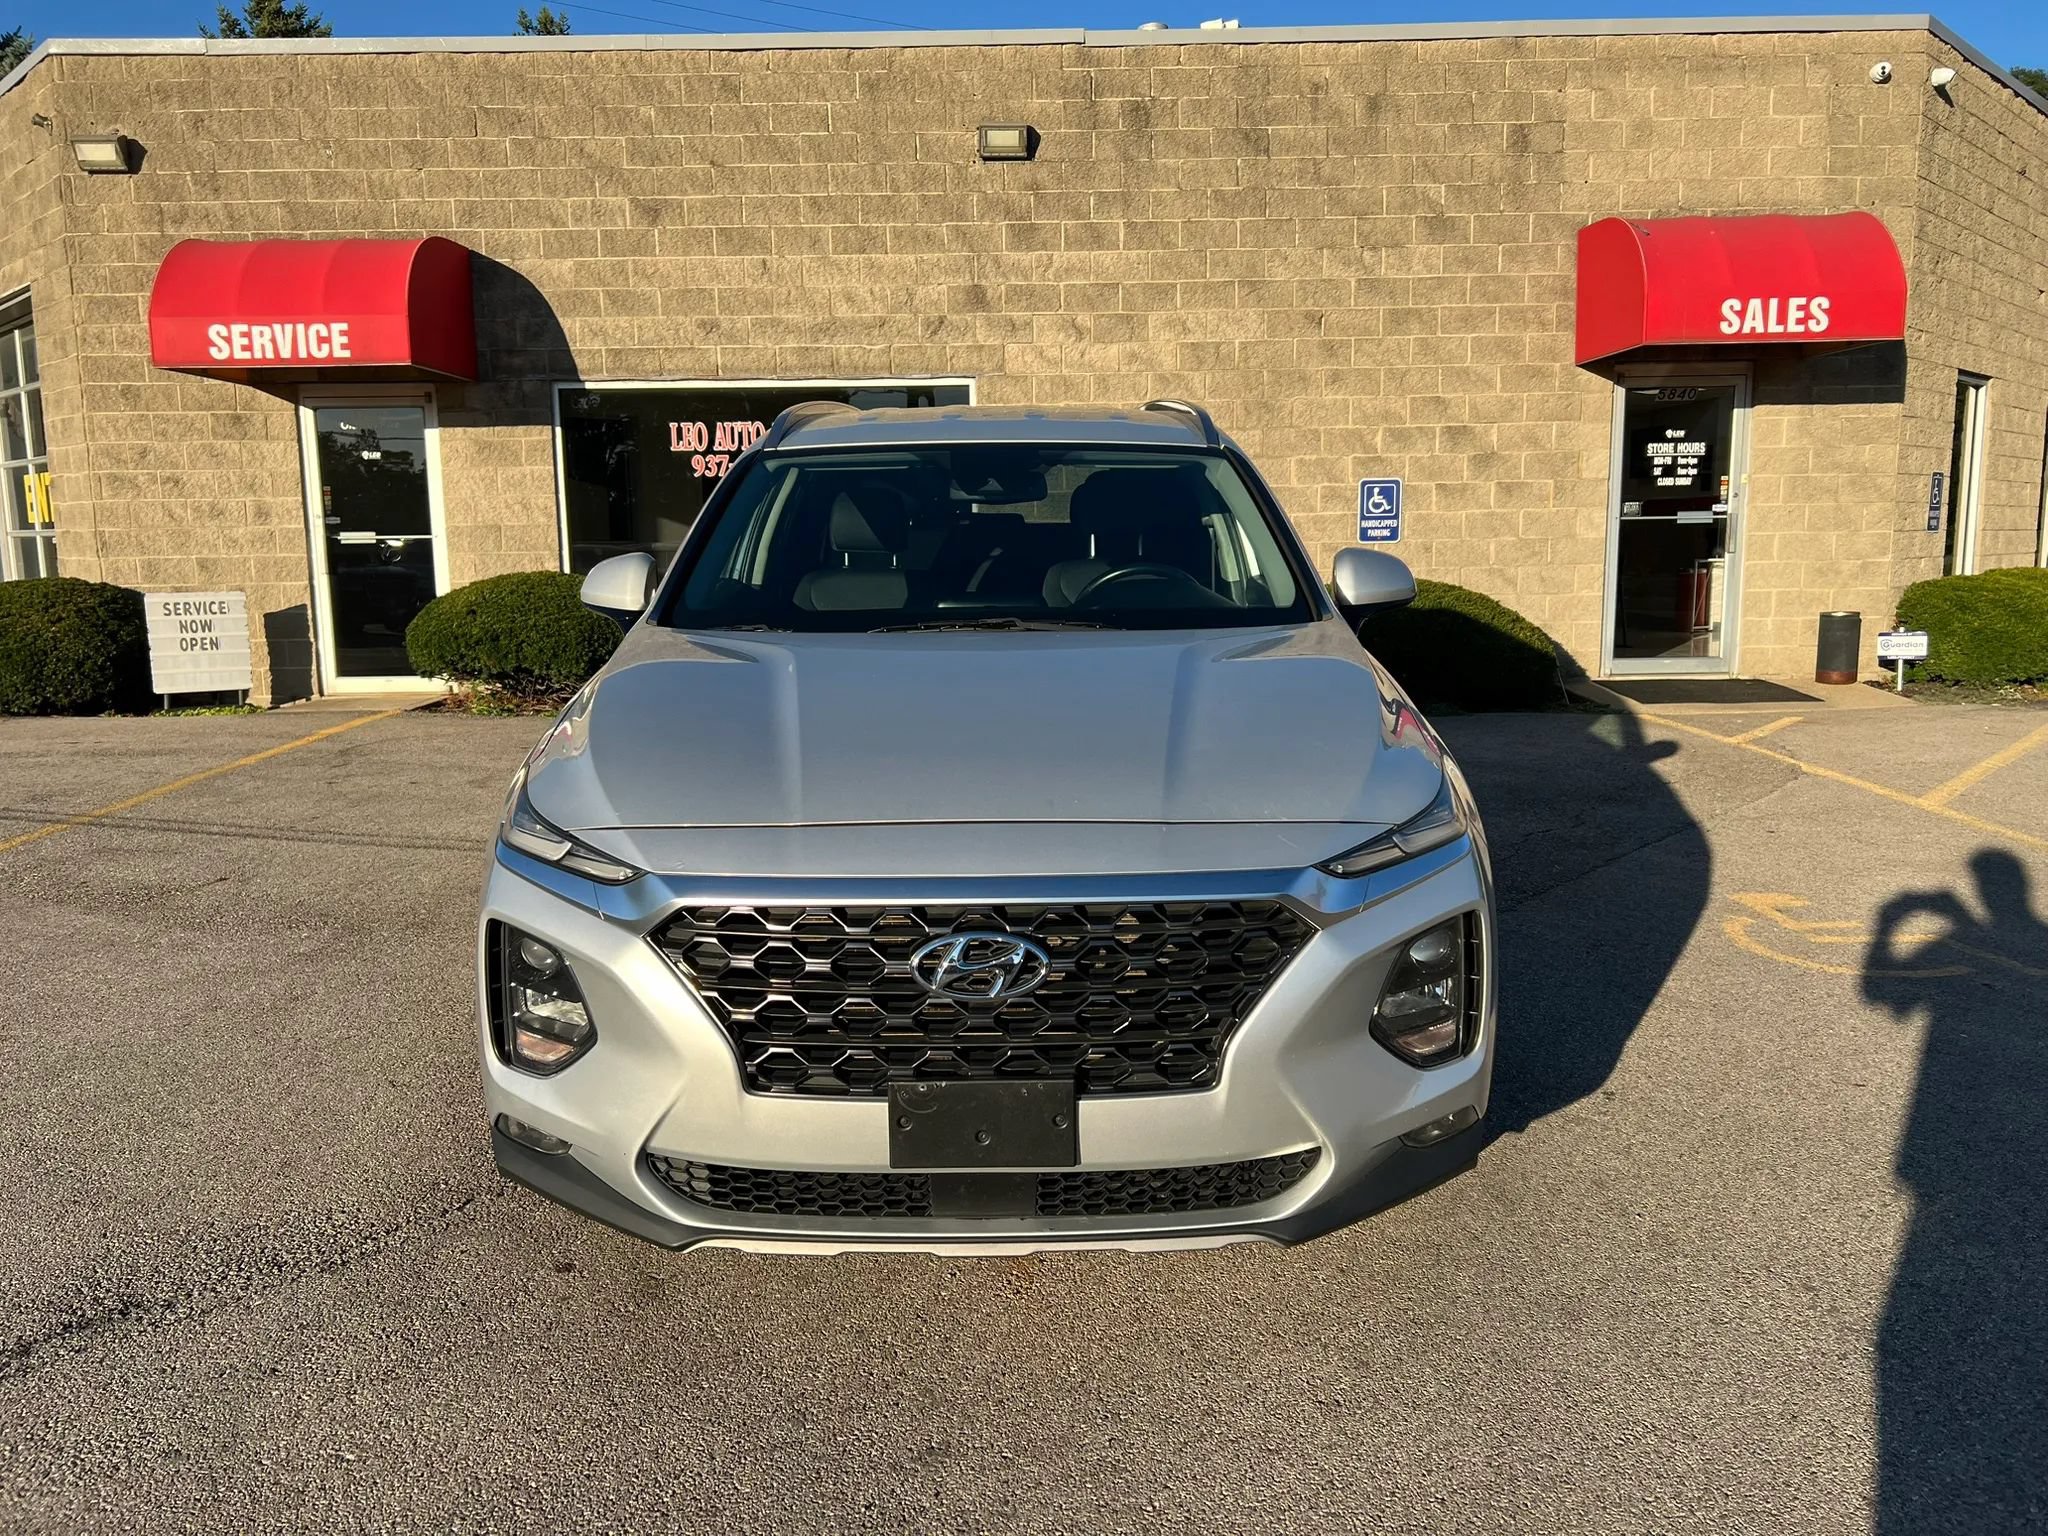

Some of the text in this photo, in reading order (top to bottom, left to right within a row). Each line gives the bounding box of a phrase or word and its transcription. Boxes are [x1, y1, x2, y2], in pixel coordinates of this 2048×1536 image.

[1719, 296, 1830, 335] SALES
[207, 322, 351, 360] SERVICE
[1657, 388, 1697, 401] 5840
[669, 421, 766, 452] LEO AUTO
[1647, 442, 1706, 454] STORE HOURS
[1657, 477, 1675, 486] CLOSED
[1360, 520, 1398, 528] HANDICAPPED
[1367, 529, 1391, 537] PARKING
[162, 601, 227, 617] SERVICE
[178, 618, 213, 634] NOW
[179, 636, 220, 652] OPEN
[1881, 640, 1924, 649] Guardian
